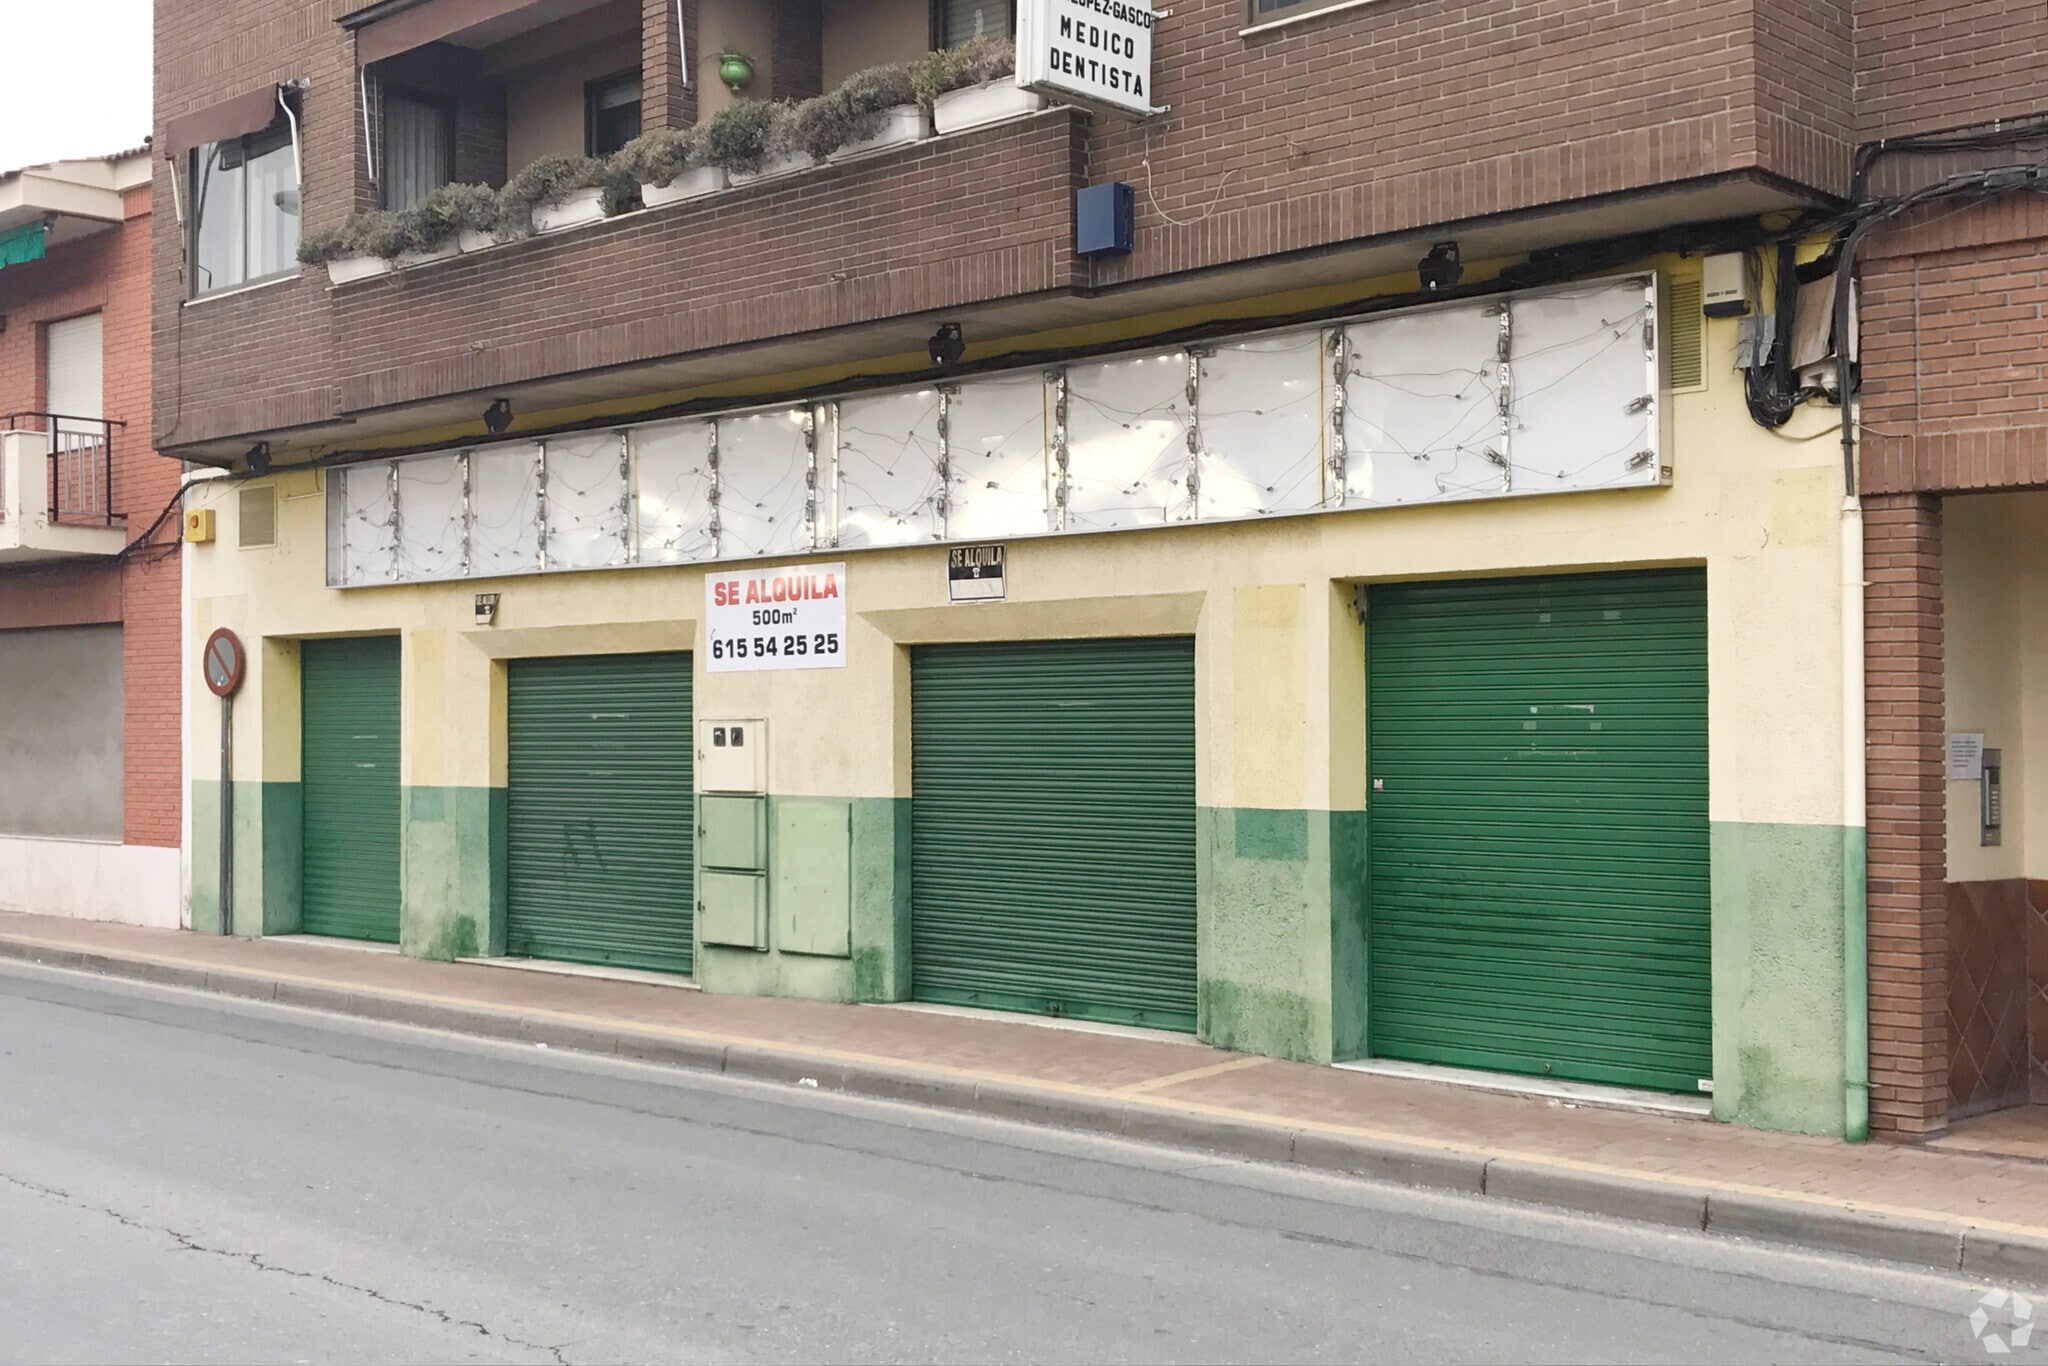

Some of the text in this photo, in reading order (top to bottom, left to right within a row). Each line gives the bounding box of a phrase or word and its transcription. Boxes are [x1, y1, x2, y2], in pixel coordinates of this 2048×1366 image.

[1060, 14, 1134, 59] MEDICO
[1050, 46, 1143, 97] DENTISTA
[950, 547, 1002, 568] SE ALQUILA
[714, 573, 838, 606] SE ALQUILA
[713, 633, 838, 659] 615 54 25 25
